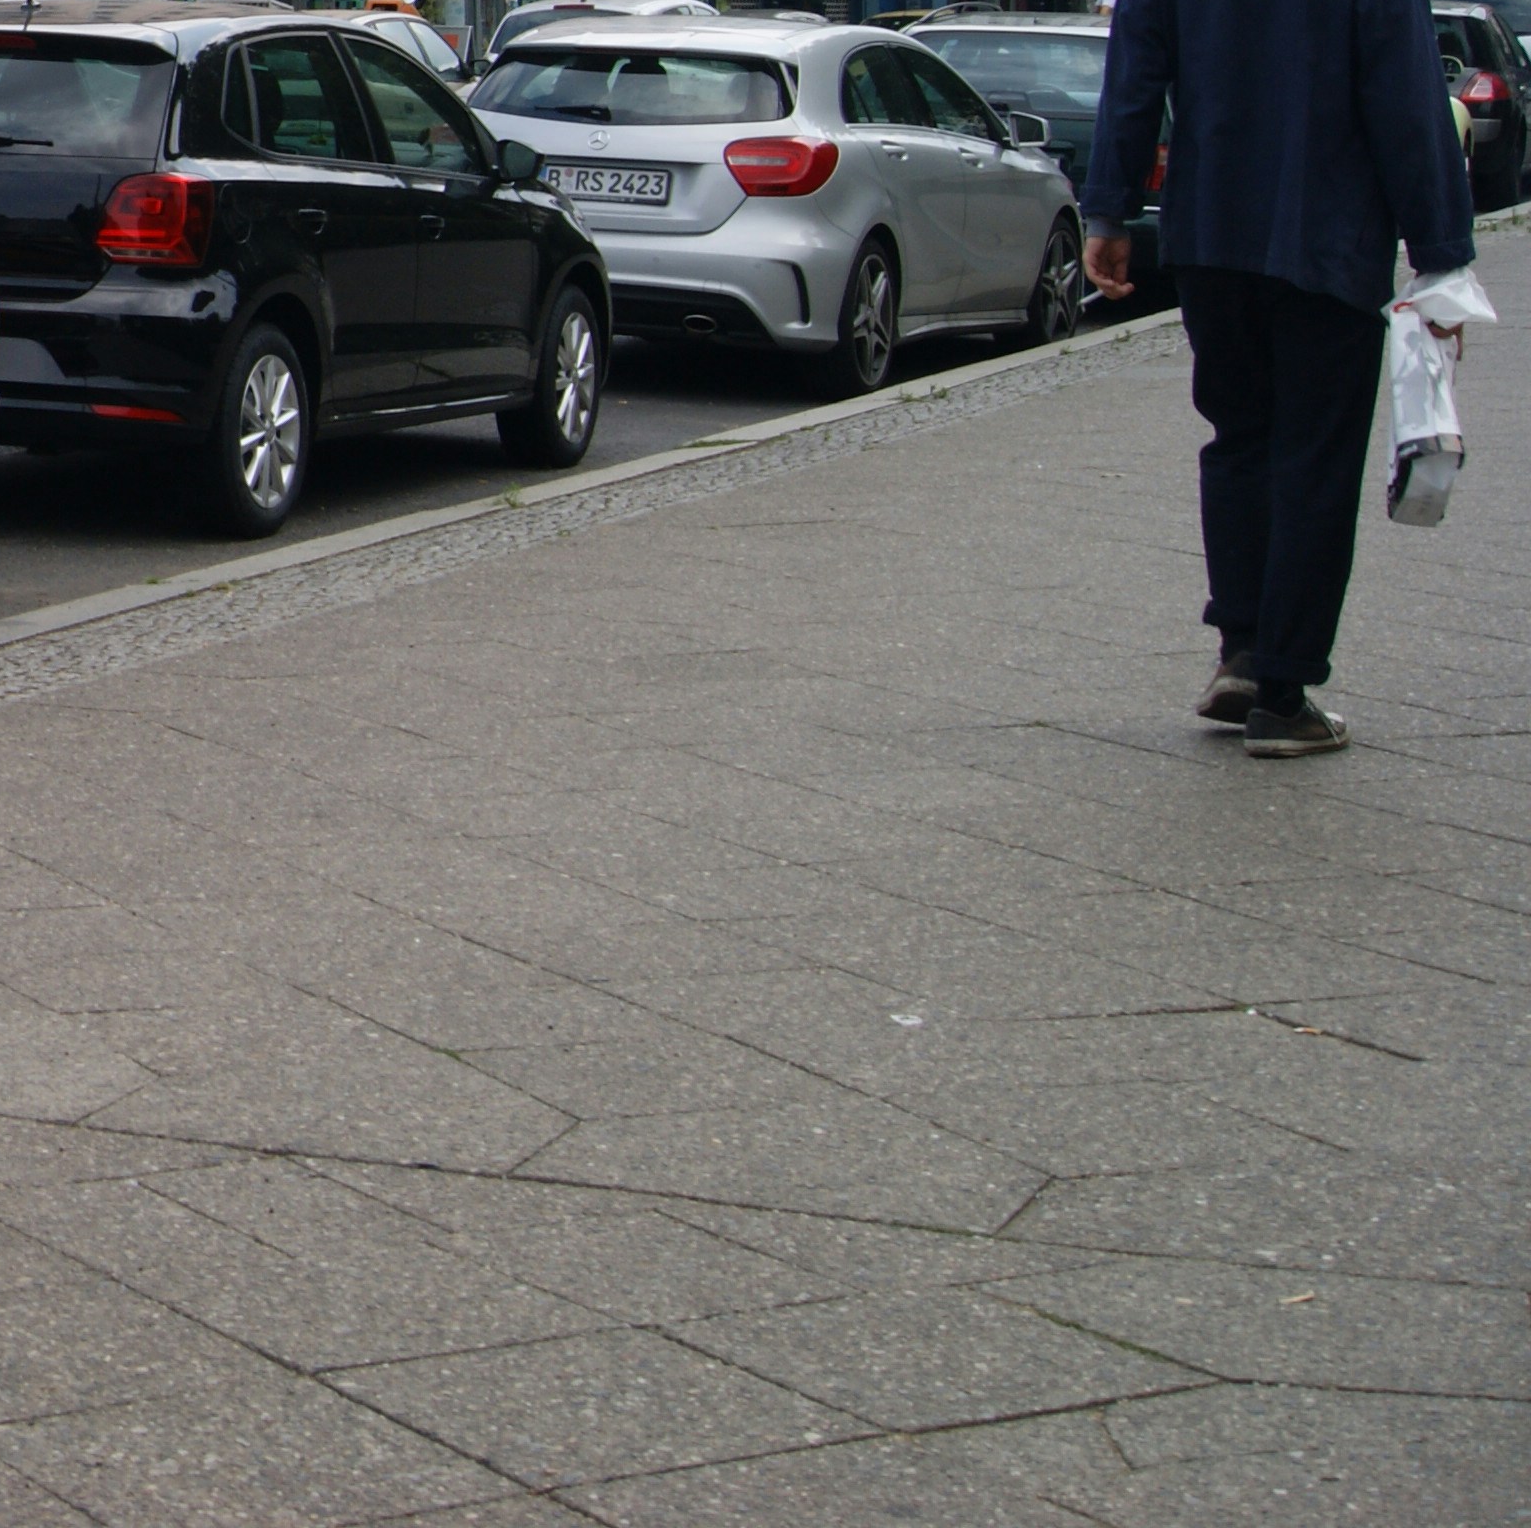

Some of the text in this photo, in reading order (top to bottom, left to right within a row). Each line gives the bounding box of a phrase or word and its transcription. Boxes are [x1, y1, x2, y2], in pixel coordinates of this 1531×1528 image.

[548, 169, 665, 196] B RS 2423
